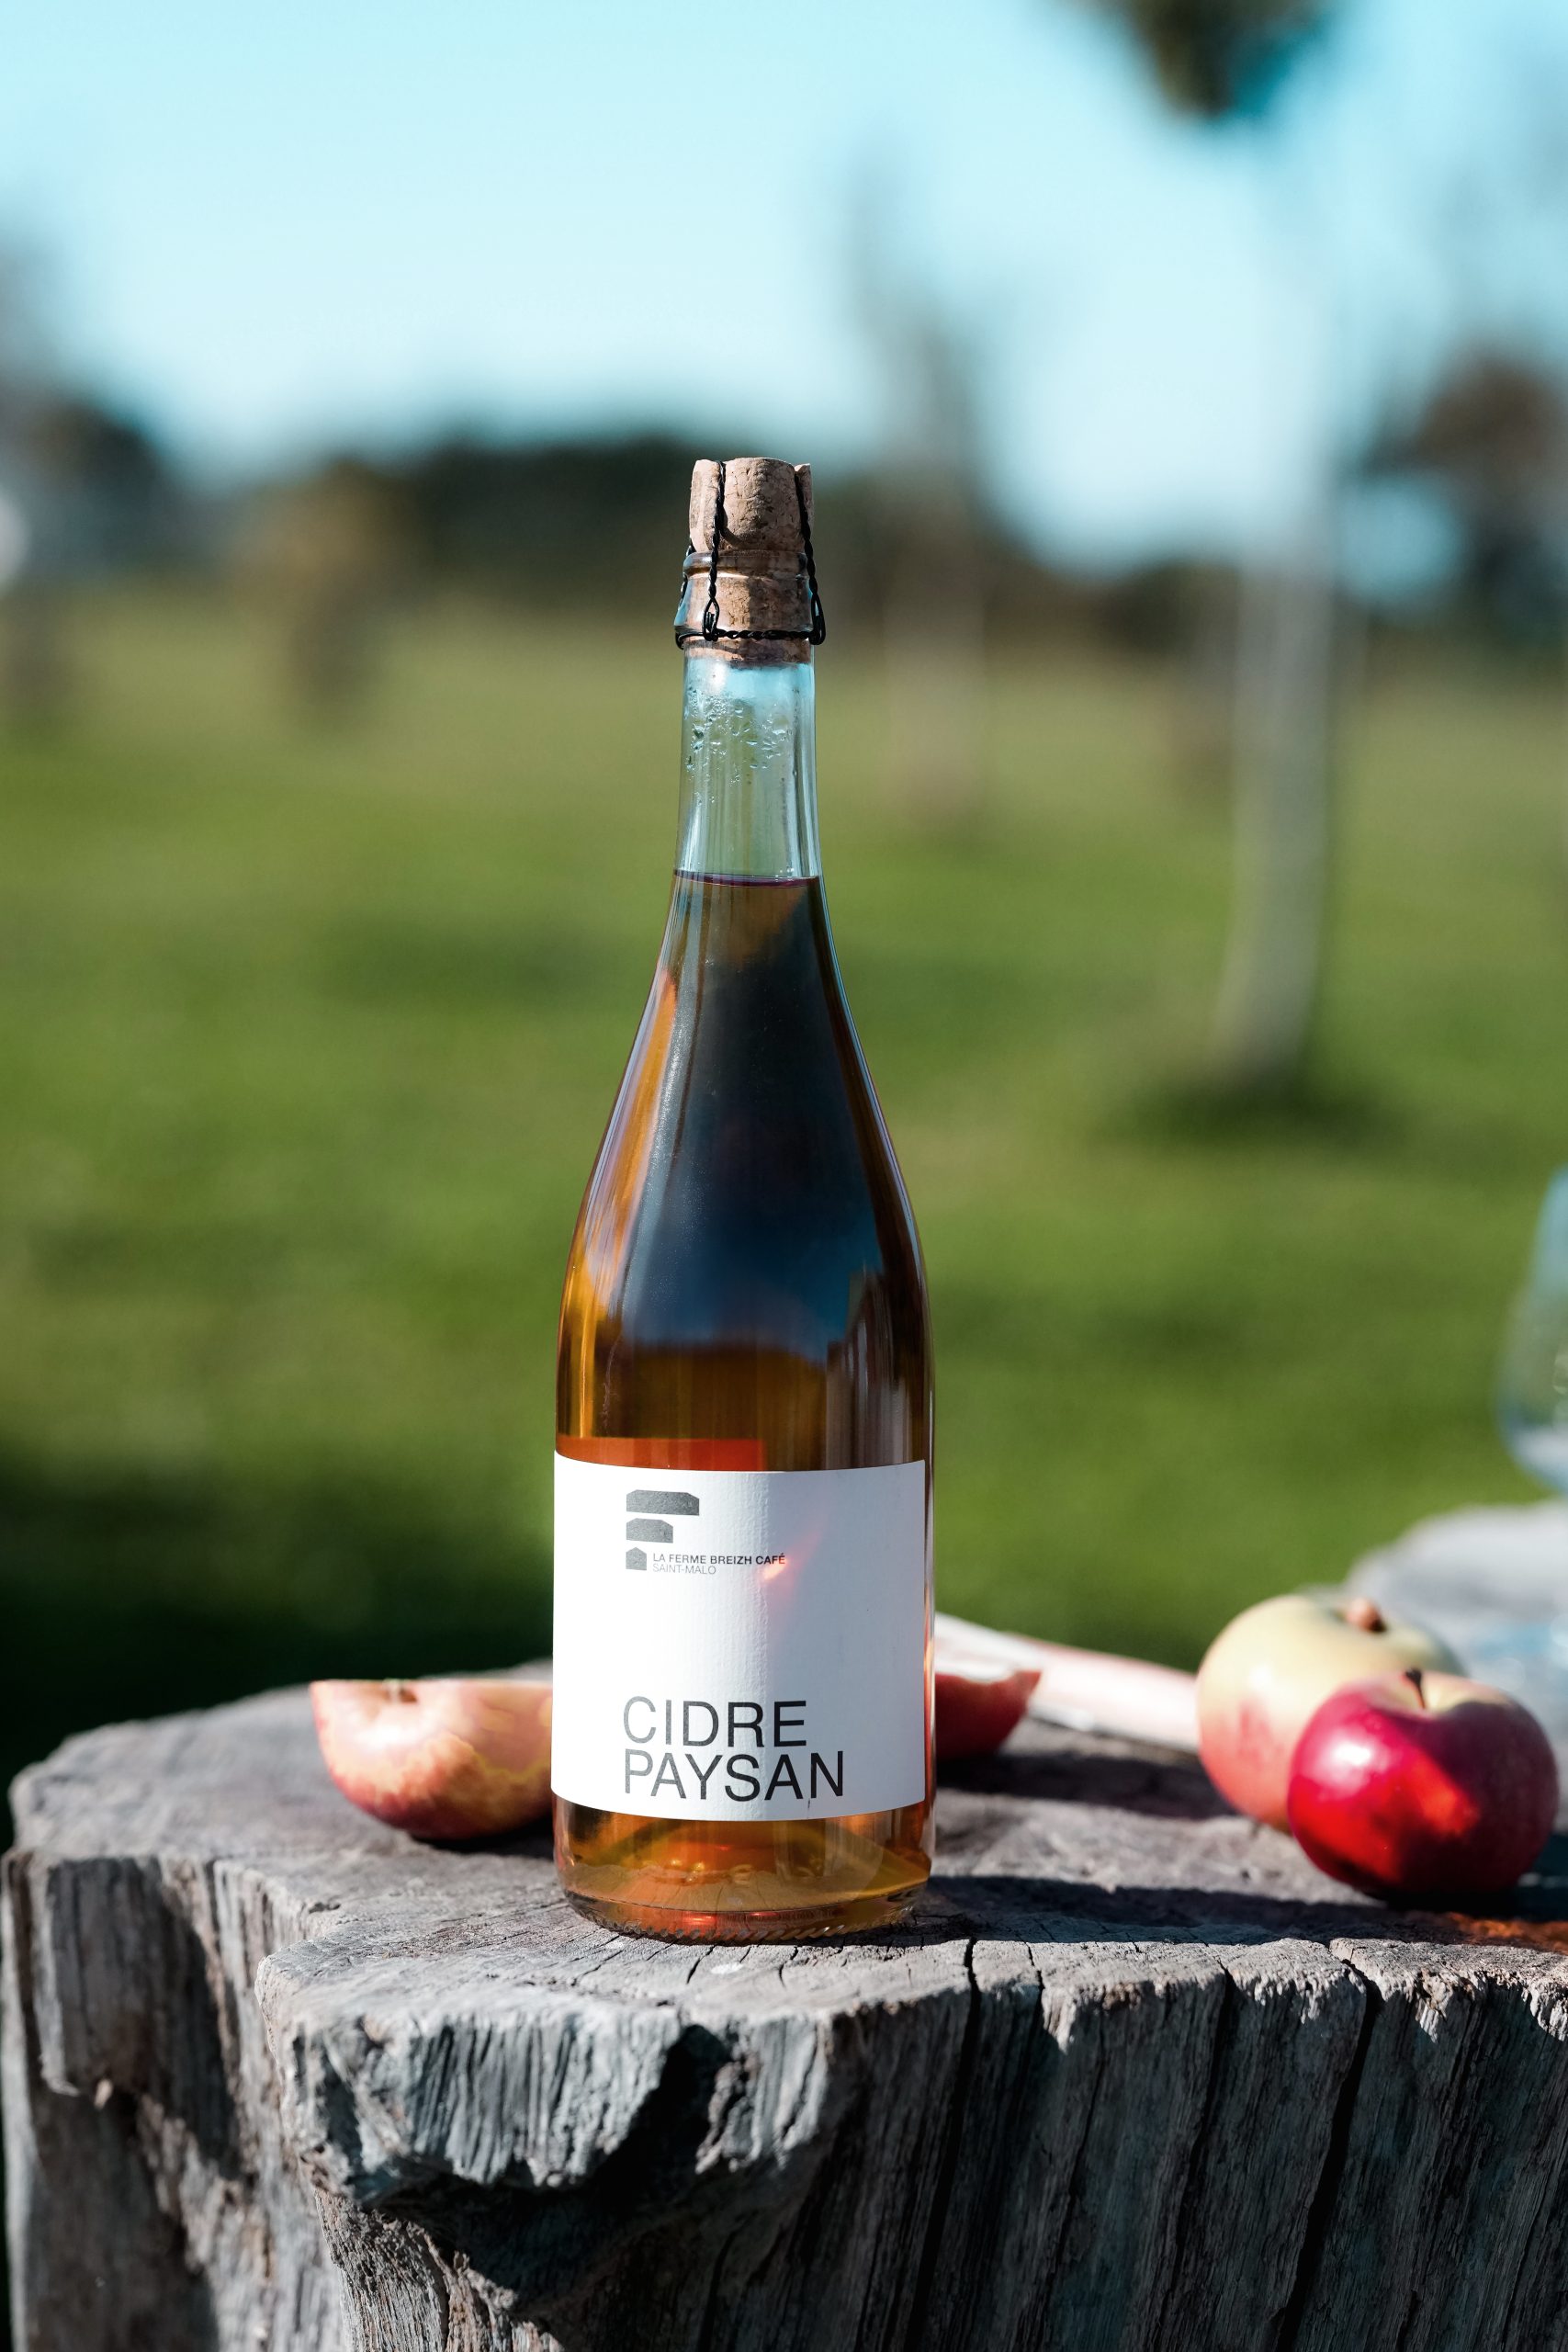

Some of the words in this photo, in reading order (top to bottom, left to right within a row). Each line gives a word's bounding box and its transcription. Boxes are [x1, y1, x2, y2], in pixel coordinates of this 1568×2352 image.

[652, 1564, 716, 1575] SAINT-MALO
[653, 1553, 666, 1563] LA
[669, 1554, 706, 1565] FERME
[710, 1555, 752, 1565] BREIZH
[755, 1553, 785, 1565] CAFÉ
[624, 1696, 807, 1747] CIDRE
[625, 1749, 843, 1802] PAYSAN
